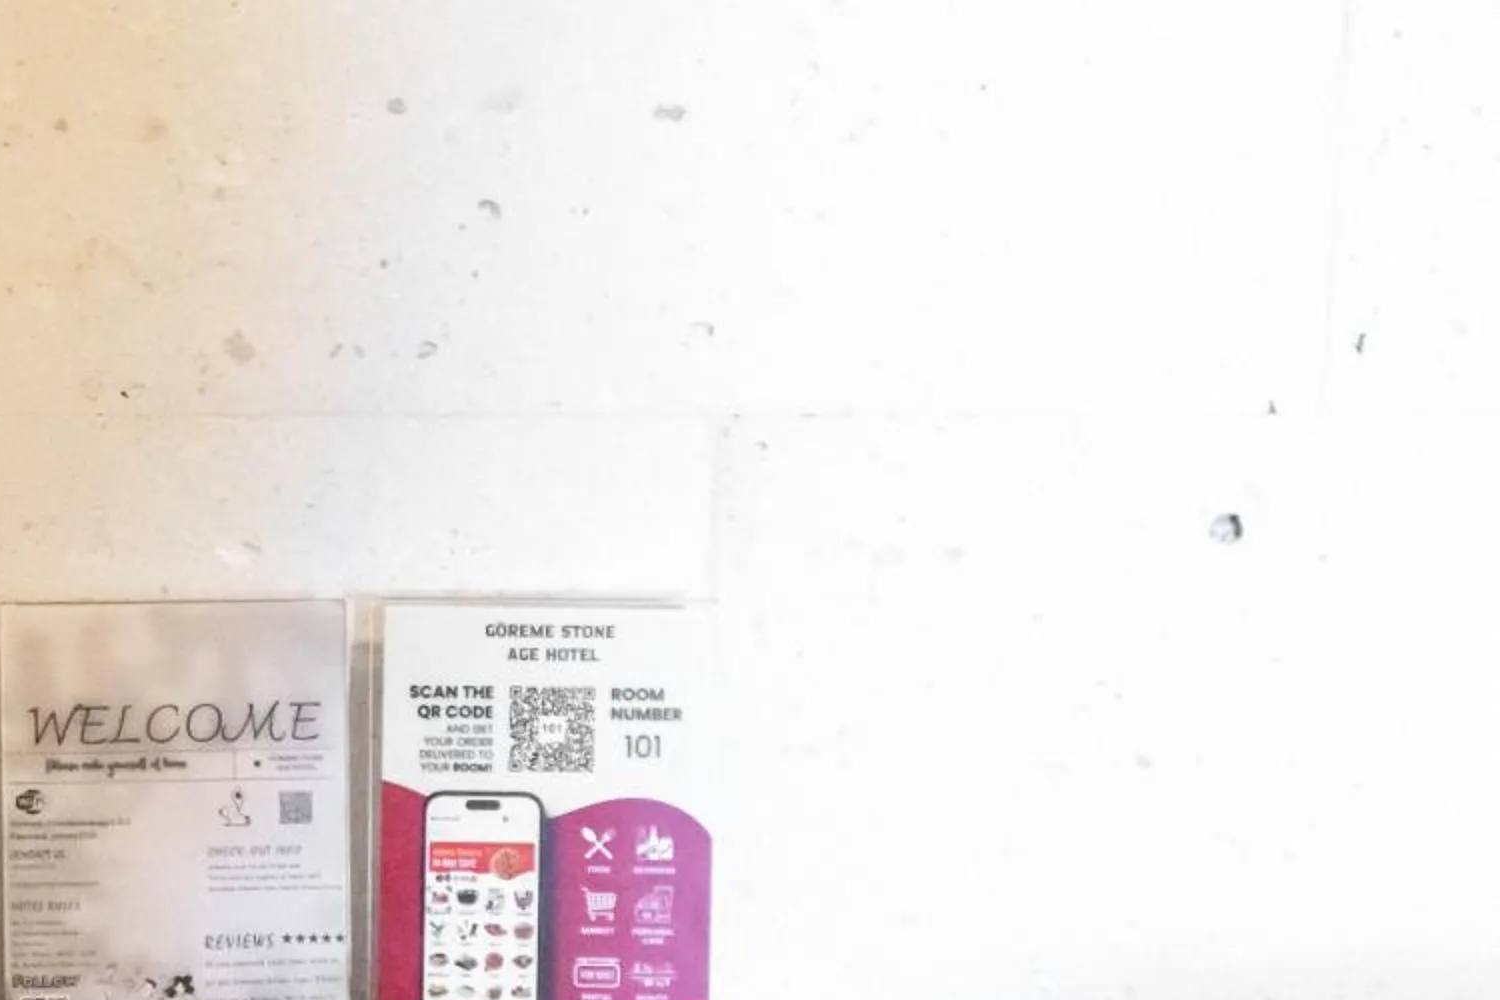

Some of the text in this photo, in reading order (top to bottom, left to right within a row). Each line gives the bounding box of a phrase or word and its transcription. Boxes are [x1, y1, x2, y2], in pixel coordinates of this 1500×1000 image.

[485, 621, 617, 640] GÖREME STONE
[508, 647, 601, 662] AGE HOTEL
[409, 685, 495, 699] SCAN THE
[611, 687, 666, 701] ROOM
[417, 704, 493, 719] QR CODE
[610, 707, 683, 721] NUMBER
[27, 701, 321, 746] WELCOME
[624, 735, 662, 759] 101
[205, 932, 276, 950] REVIEWS
